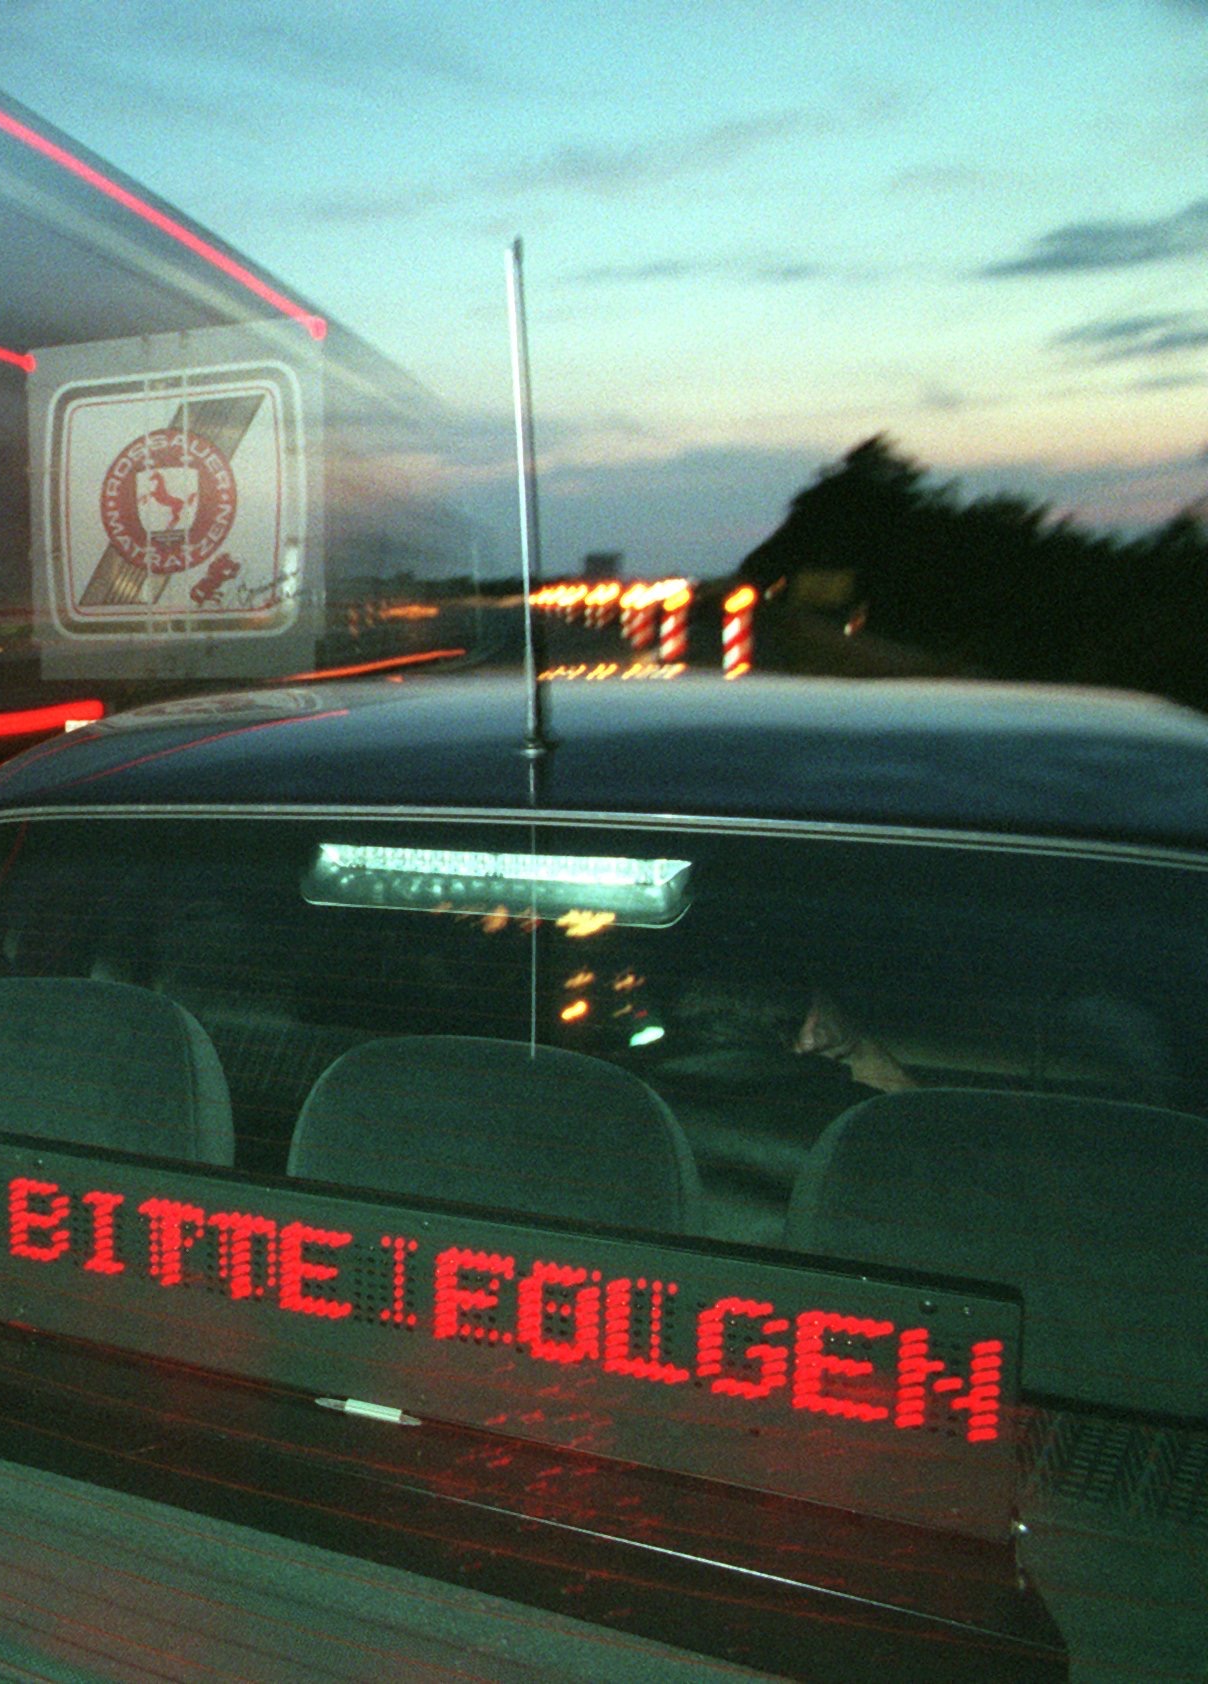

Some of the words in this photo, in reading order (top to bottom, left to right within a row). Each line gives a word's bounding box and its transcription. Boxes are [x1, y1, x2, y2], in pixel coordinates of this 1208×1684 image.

[107, 503, 233, 568] MATRATZEN
[8, 1177, 353, 1321] BITTE
[433, 1246, 1003, 1443] FOLGEN
